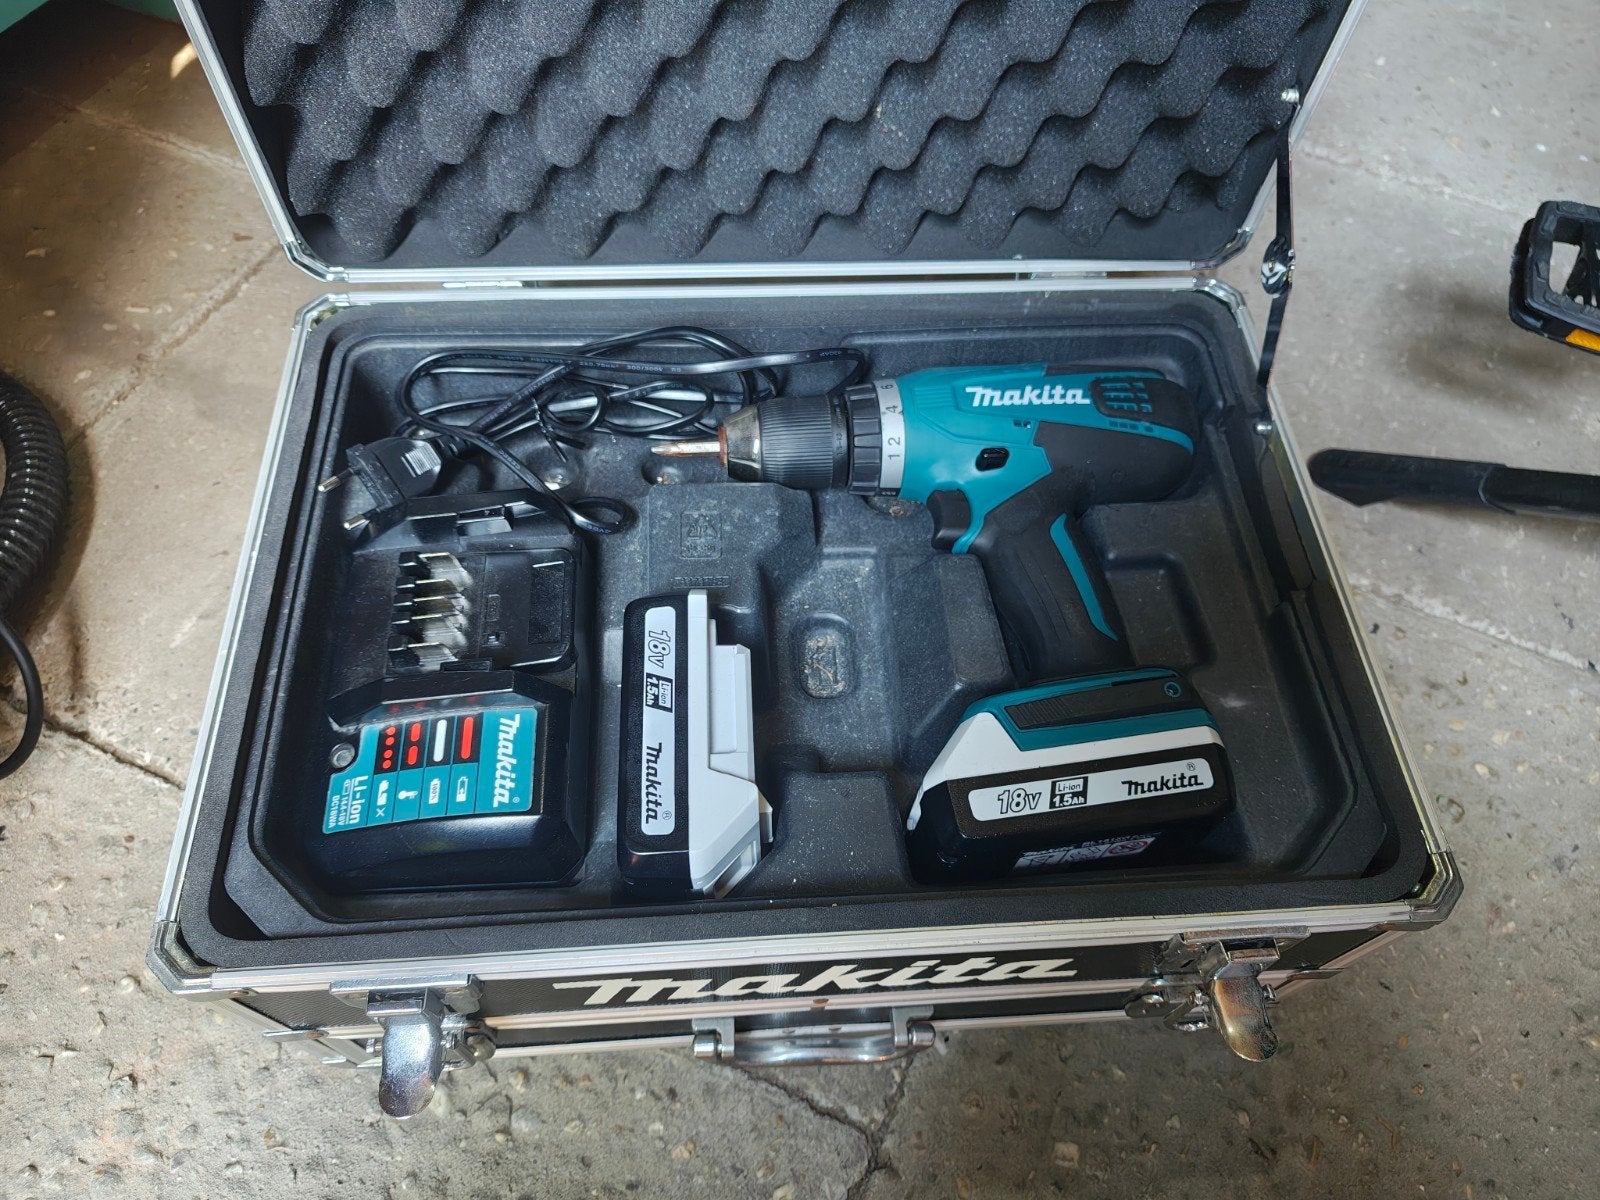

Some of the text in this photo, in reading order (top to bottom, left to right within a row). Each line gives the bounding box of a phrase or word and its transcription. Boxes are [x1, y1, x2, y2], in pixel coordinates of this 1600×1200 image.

[886, 404, 898, 414] 4
[887, 436, 901, 446] 2
[646, 676, 659, 707] 1.5Ah
[660, 682, 670, 705] Li-ion
[1057, 781, 1082, 793] Li-ion
[1053, 793, 1085, 808] 1.5Ah
